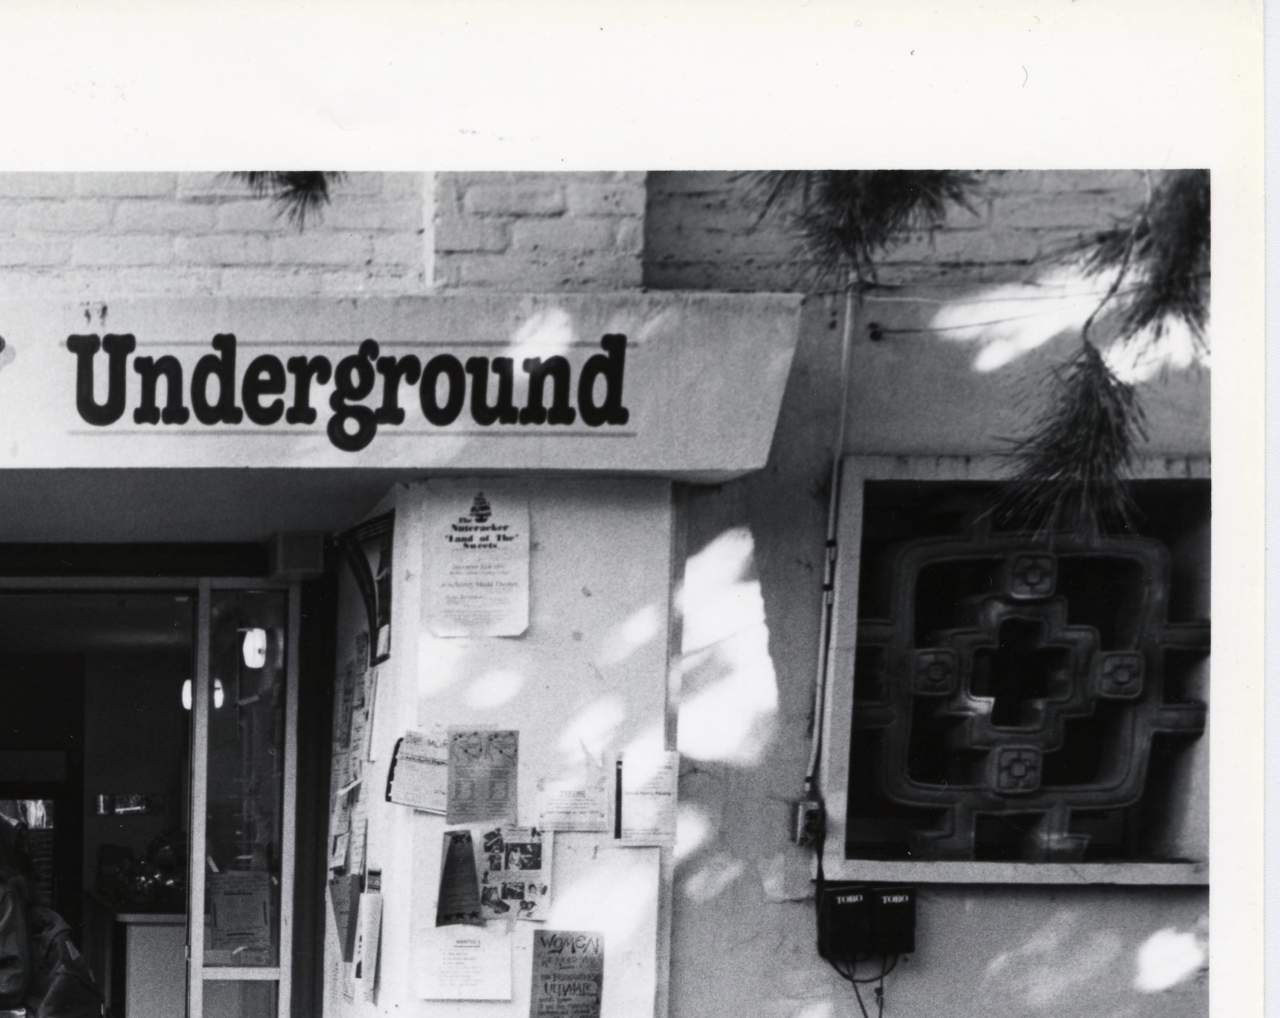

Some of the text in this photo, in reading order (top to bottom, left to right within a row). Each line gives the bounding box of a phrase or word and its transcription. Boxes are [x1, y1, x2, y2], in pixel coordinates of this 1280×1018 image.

[66, 333, 630, 452] Underground
[451, 523, 510, 532] Nutcracker
[479, 534, 490, 542] of
[836, 894, 864, 904] TORO
[882, 895, 909, 904] TORO
[539, 934, 600, 955] WOMEN
